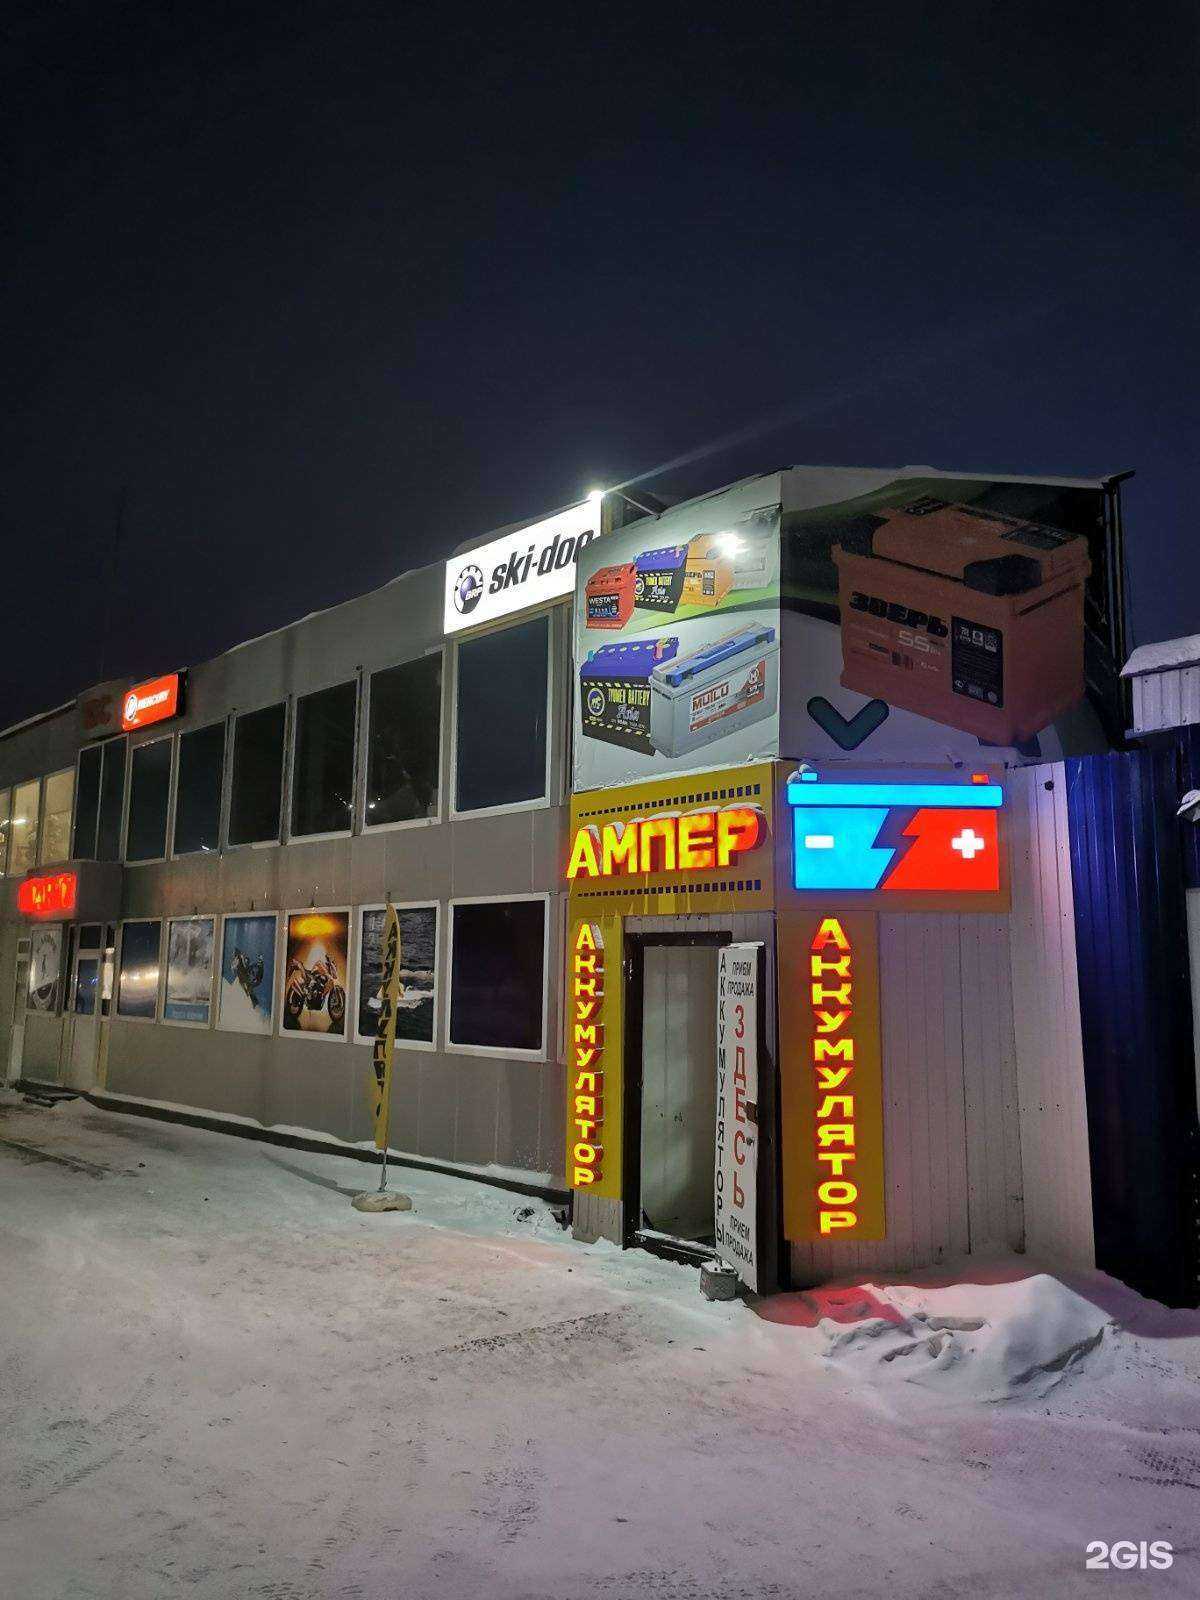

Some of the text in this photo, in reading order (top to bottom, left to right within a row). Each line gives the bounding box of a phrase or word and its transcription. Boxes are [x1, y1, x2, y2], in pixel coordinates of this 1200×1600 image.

[567, 806, 763, 878] АМПЕР
[727, 980, 754, 997] ПРОДАЖА
[731, 961, 752, 976] ПРИЕМ
[574, 922, 601, 1187] АККУМУЛЯТОР
[811, 917, 858, 1235] АККУМУЛЯТОР
[715, 953, 727, 1245] АККУМУЛЯТОРЫ
[733, 1004, 746, 1210] ЗДЕСЬ
[725, 1232, 754, 1268] ПРОДАЖА
[730, 1214, 751, 1242] ПРИЕМ
